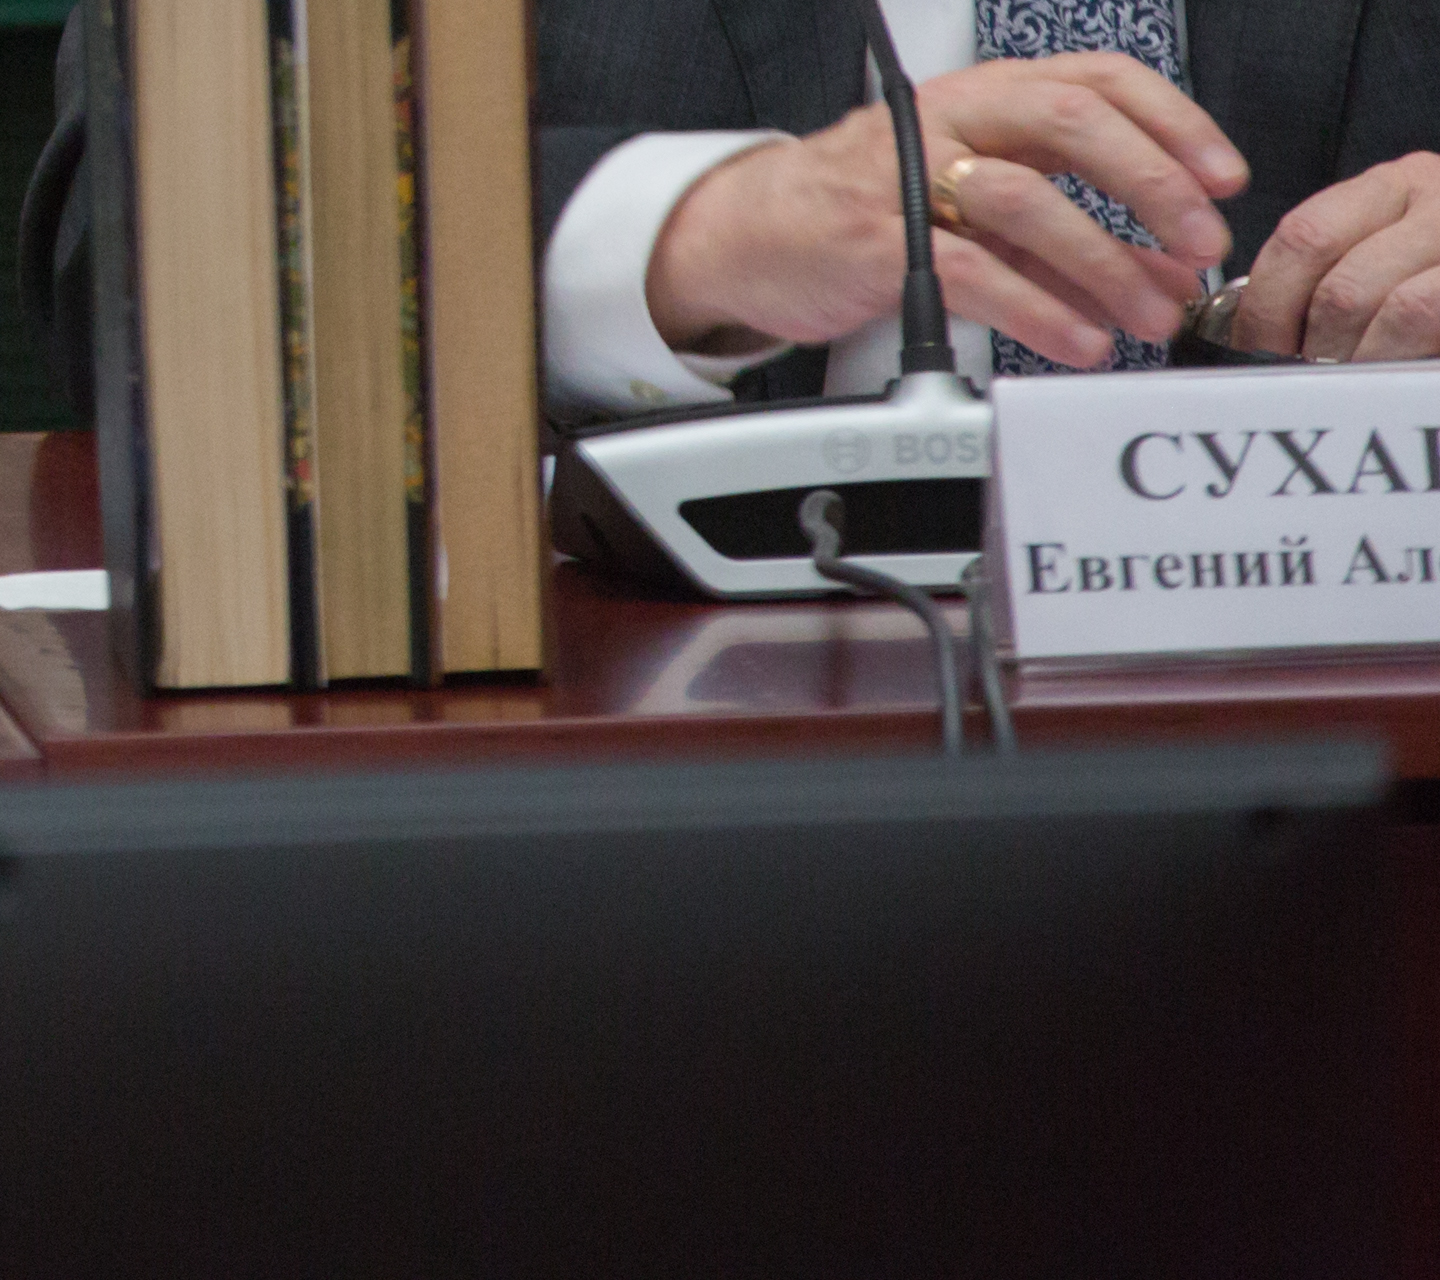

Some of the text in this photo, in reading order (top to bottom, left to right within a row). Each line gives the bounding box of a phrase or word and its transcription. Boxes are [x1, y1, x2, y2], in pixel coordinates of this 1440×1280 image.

[894, 430, 988, 466] BOS
[1024, 535, 1440, 596] Евгений Ал
